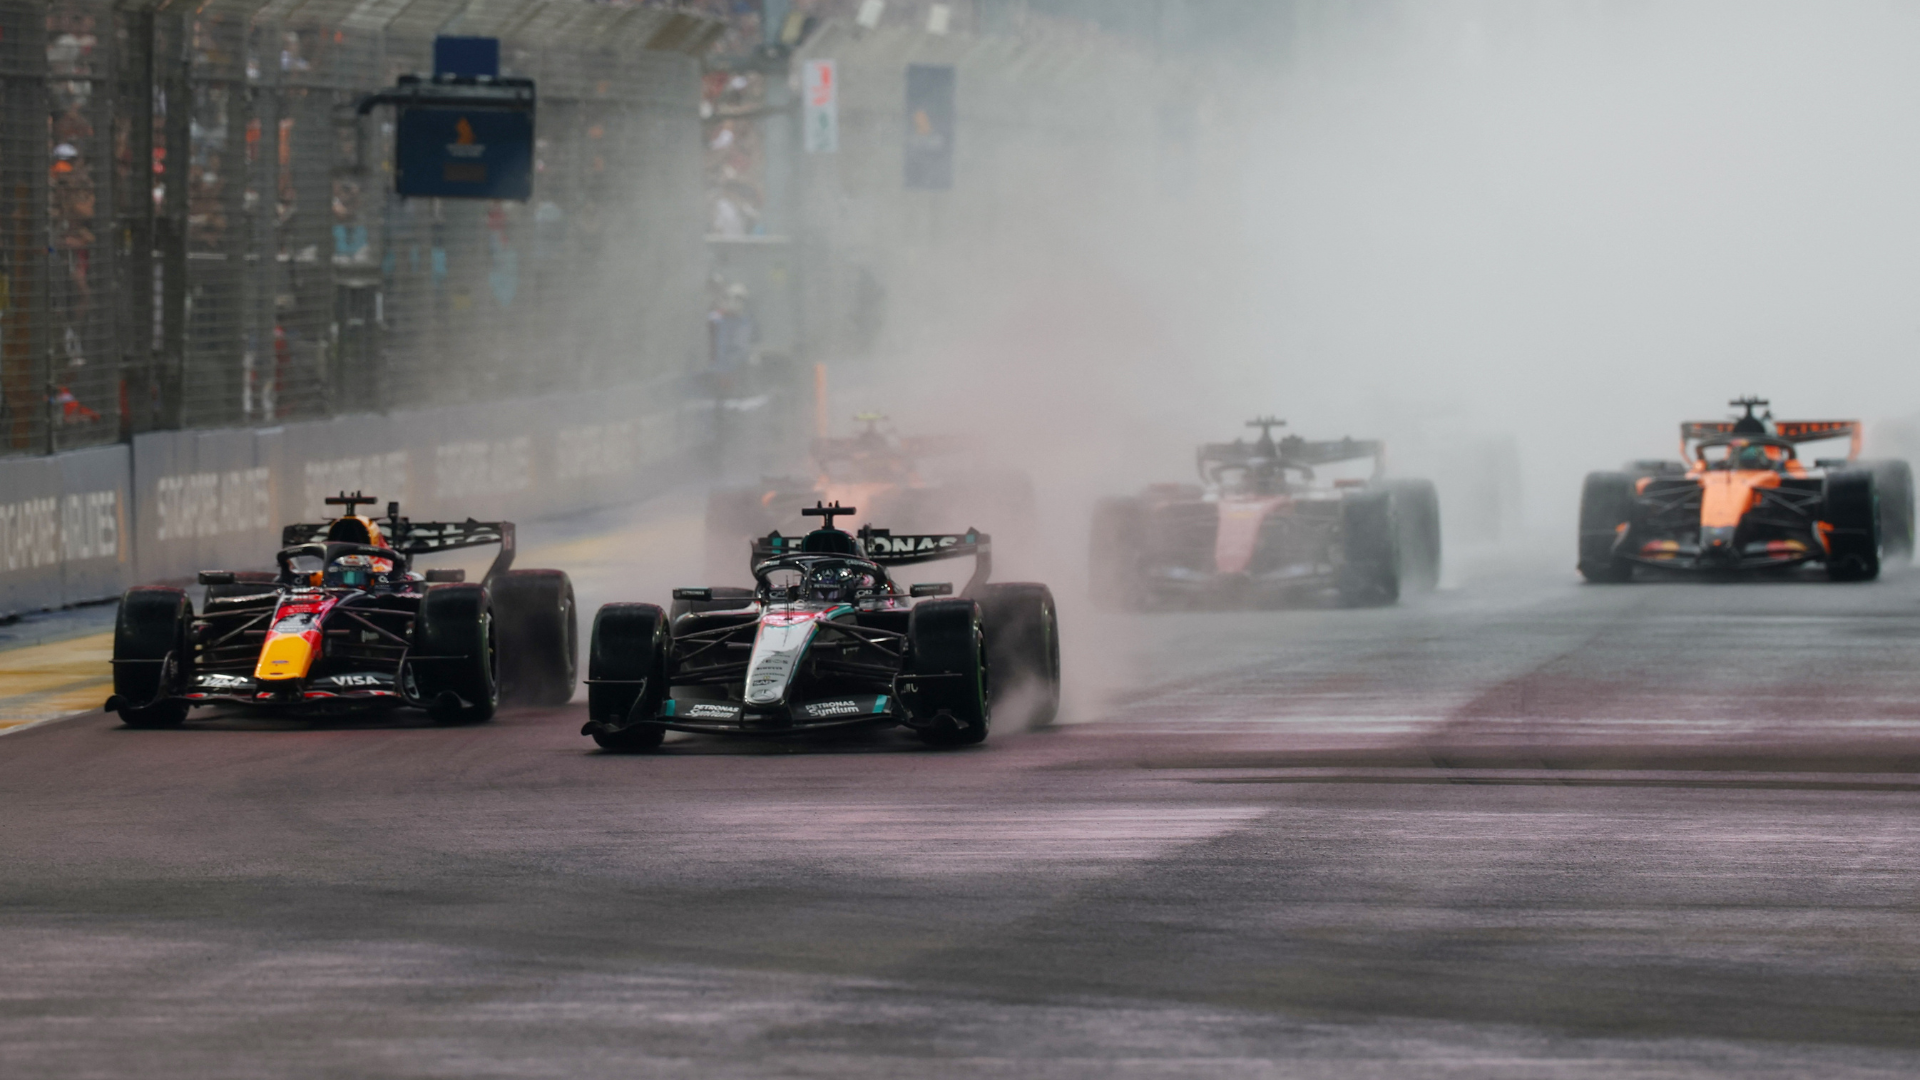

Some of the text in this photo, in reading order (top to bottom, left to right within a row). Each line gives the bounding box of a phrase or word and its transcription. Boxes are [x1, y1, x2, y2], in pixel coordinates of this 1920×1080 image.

[331, 675, 381, 686] VISA
[693, 704, 739, 712] PETRONAS
[805, 700, 856, 711] PETRONAS
[808, 706, 860, 717] Syntium
